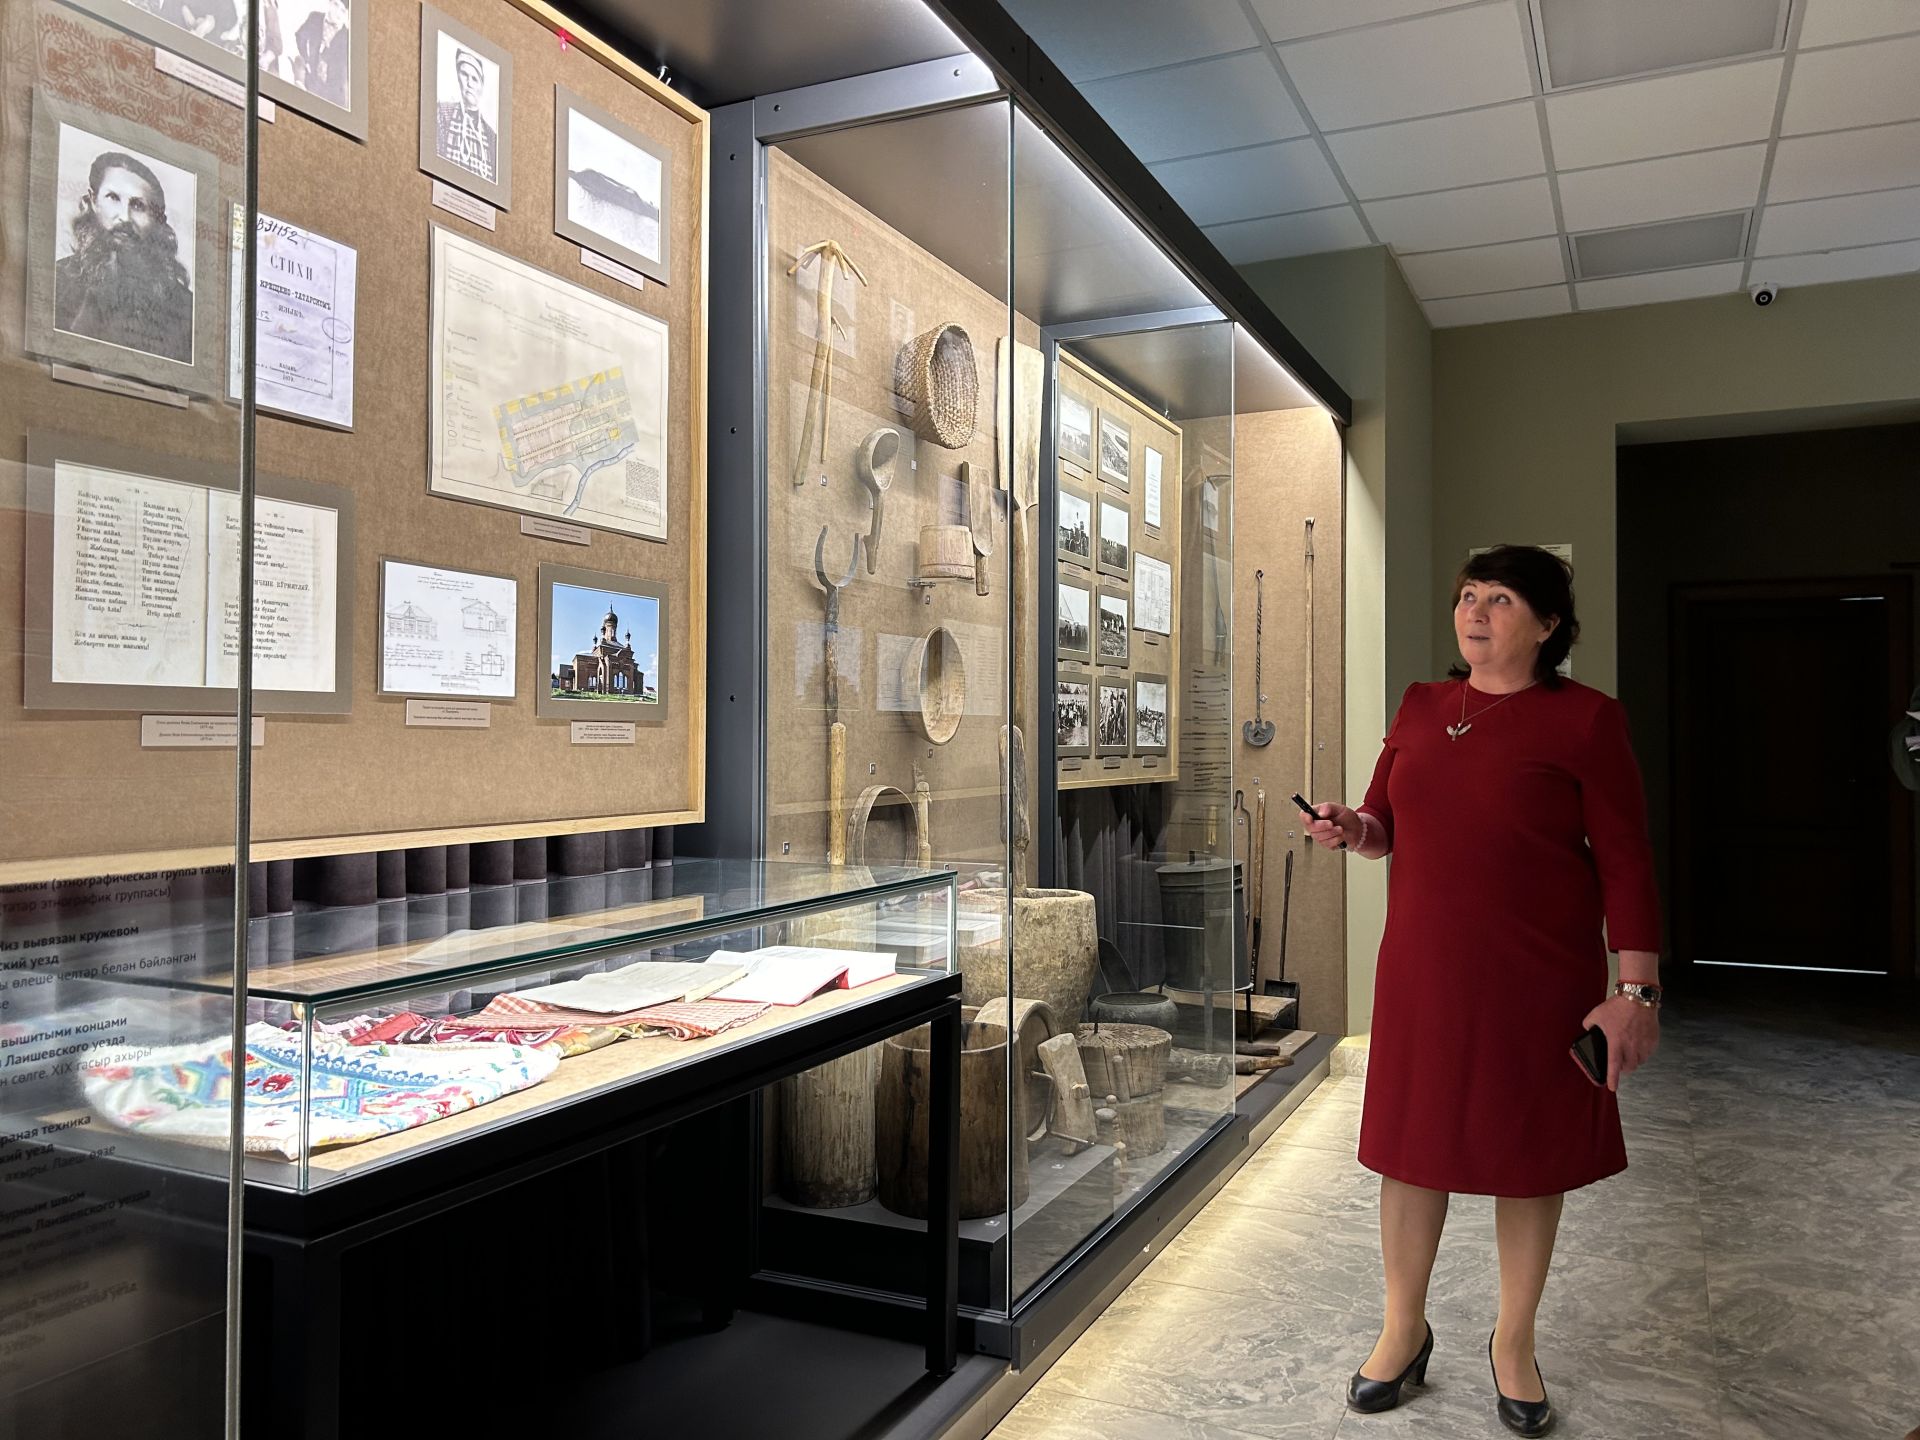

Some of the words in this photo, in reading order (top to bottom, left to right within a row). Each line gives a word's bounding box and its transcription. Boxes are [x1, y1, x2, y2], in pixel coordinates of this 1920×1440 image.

[270, 254, 313, 280] СТИХИ
[52, 872, 158, 892] (этнографическая
[161, 867, 197, 881] группа
[200, 863, 232, 876] татар)
[115, 886, 171, 902] группасы)
[23, 934, 76, 949] вывязан
[80, 926, 139, 944] кружевом
[12, 974, 54, 989] өлеше
[57, 966, 98, 980] челтәр
[101, 961, 136, 975] белән
[139, 952, 196, 969] бәйләнгән
[30, 955, 59, 969] уезд
[1, 1028, 72, 1048] вышитыми
[75, 1017, 127, 1034] концами
[5, 1043, 89, 1067] Лаишевского
[92, 1035, 126, 1051] уезда
[11, 1069, 48, 1085] сөлге.
[51, 1062, 74, 1077] XIX
[77, 1056, 111, 1070] гасыр
[115, 1048, 153, 1063] ахыры
[41, 1115, 91, 1134] техника
[25, 1143, 55, 1160] уезд
[50, 1191, 86, 1208] швом
